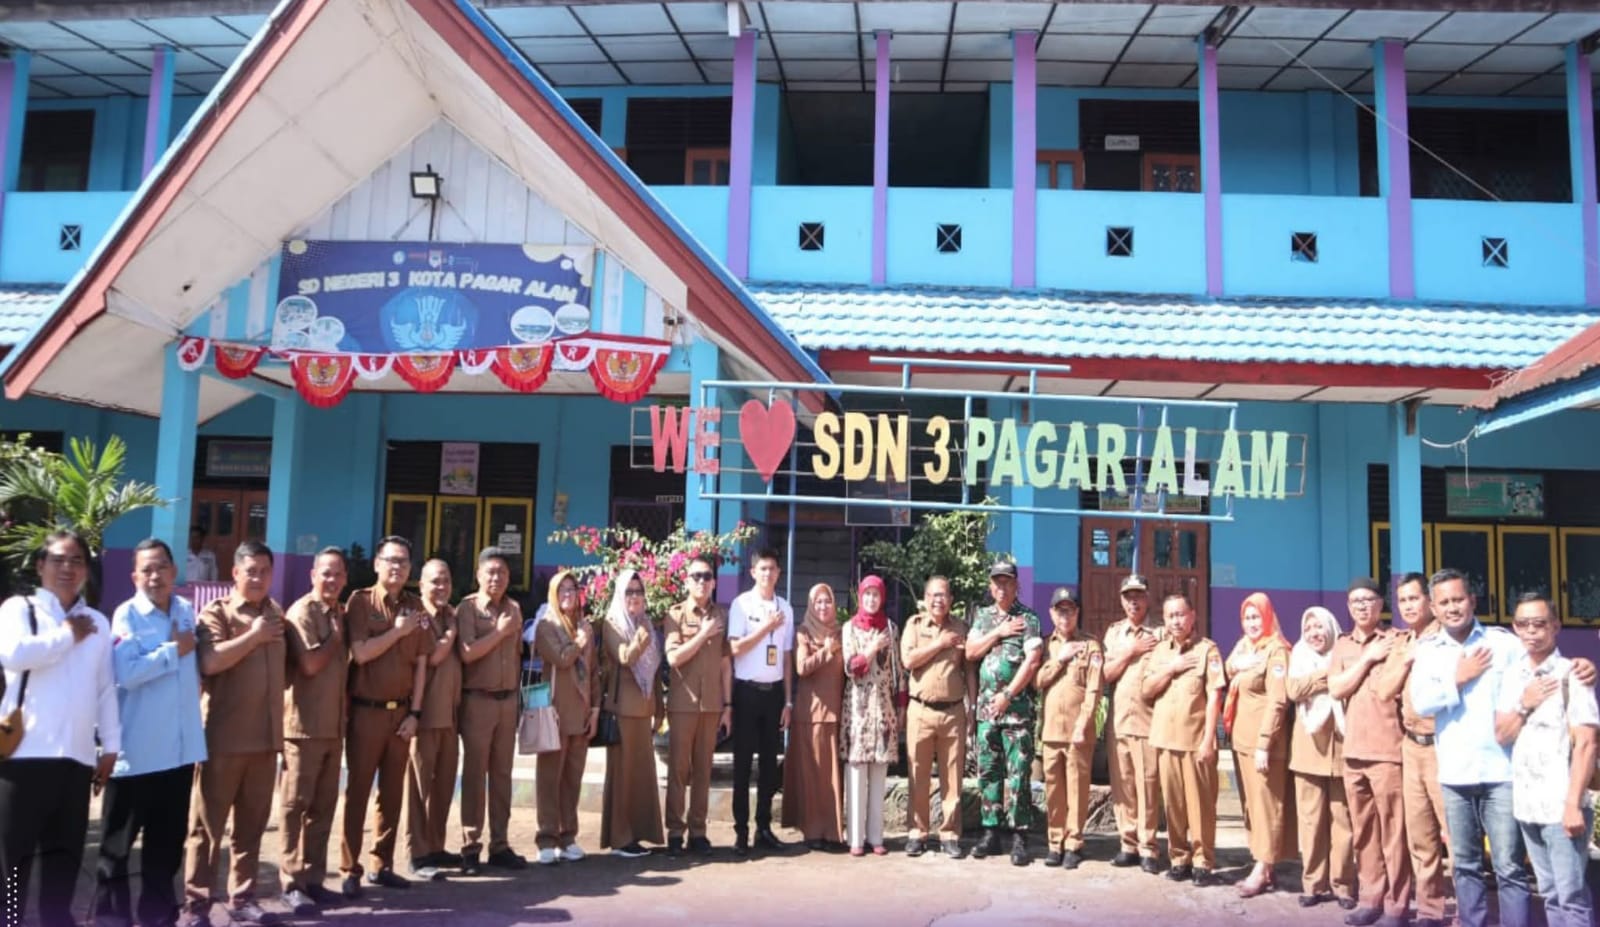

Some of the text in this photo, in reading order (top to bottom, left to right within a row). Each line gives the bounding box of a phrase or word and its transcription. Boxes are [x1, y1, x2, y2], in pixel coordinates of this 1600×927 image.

[298, 271, 578, 304] SD NEGERI 3 KOTA PAGAR ALAM
[650, 405, 1290, 500] WE SDN 3 PAGAR ALAM
